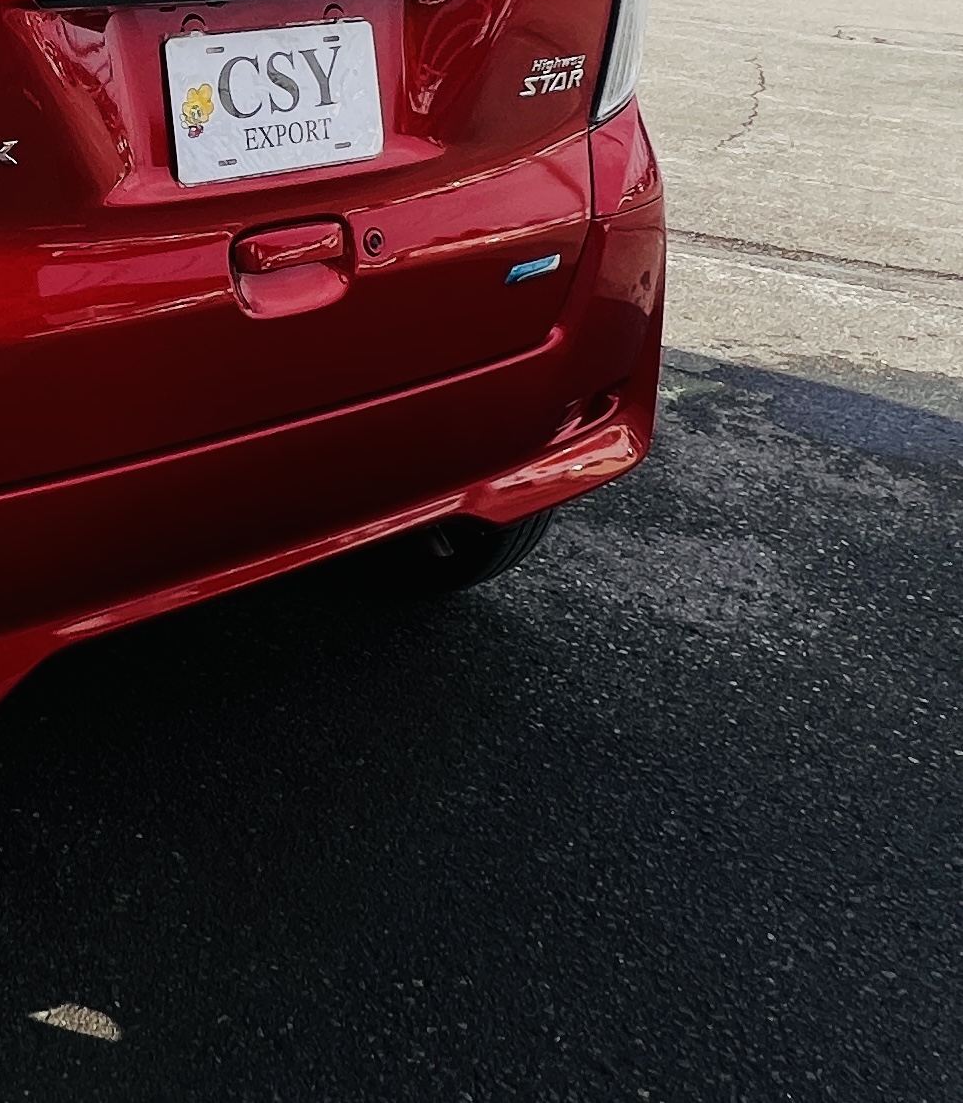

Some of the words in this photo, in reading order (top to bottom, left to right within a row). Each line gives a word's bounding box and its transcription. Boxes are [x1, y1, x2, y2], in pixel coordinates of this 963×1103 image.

[217, 46, 342, 119] CSY
[519, 68, 584, 97] STAR
[243, 118, 332, 151] EXPORT
